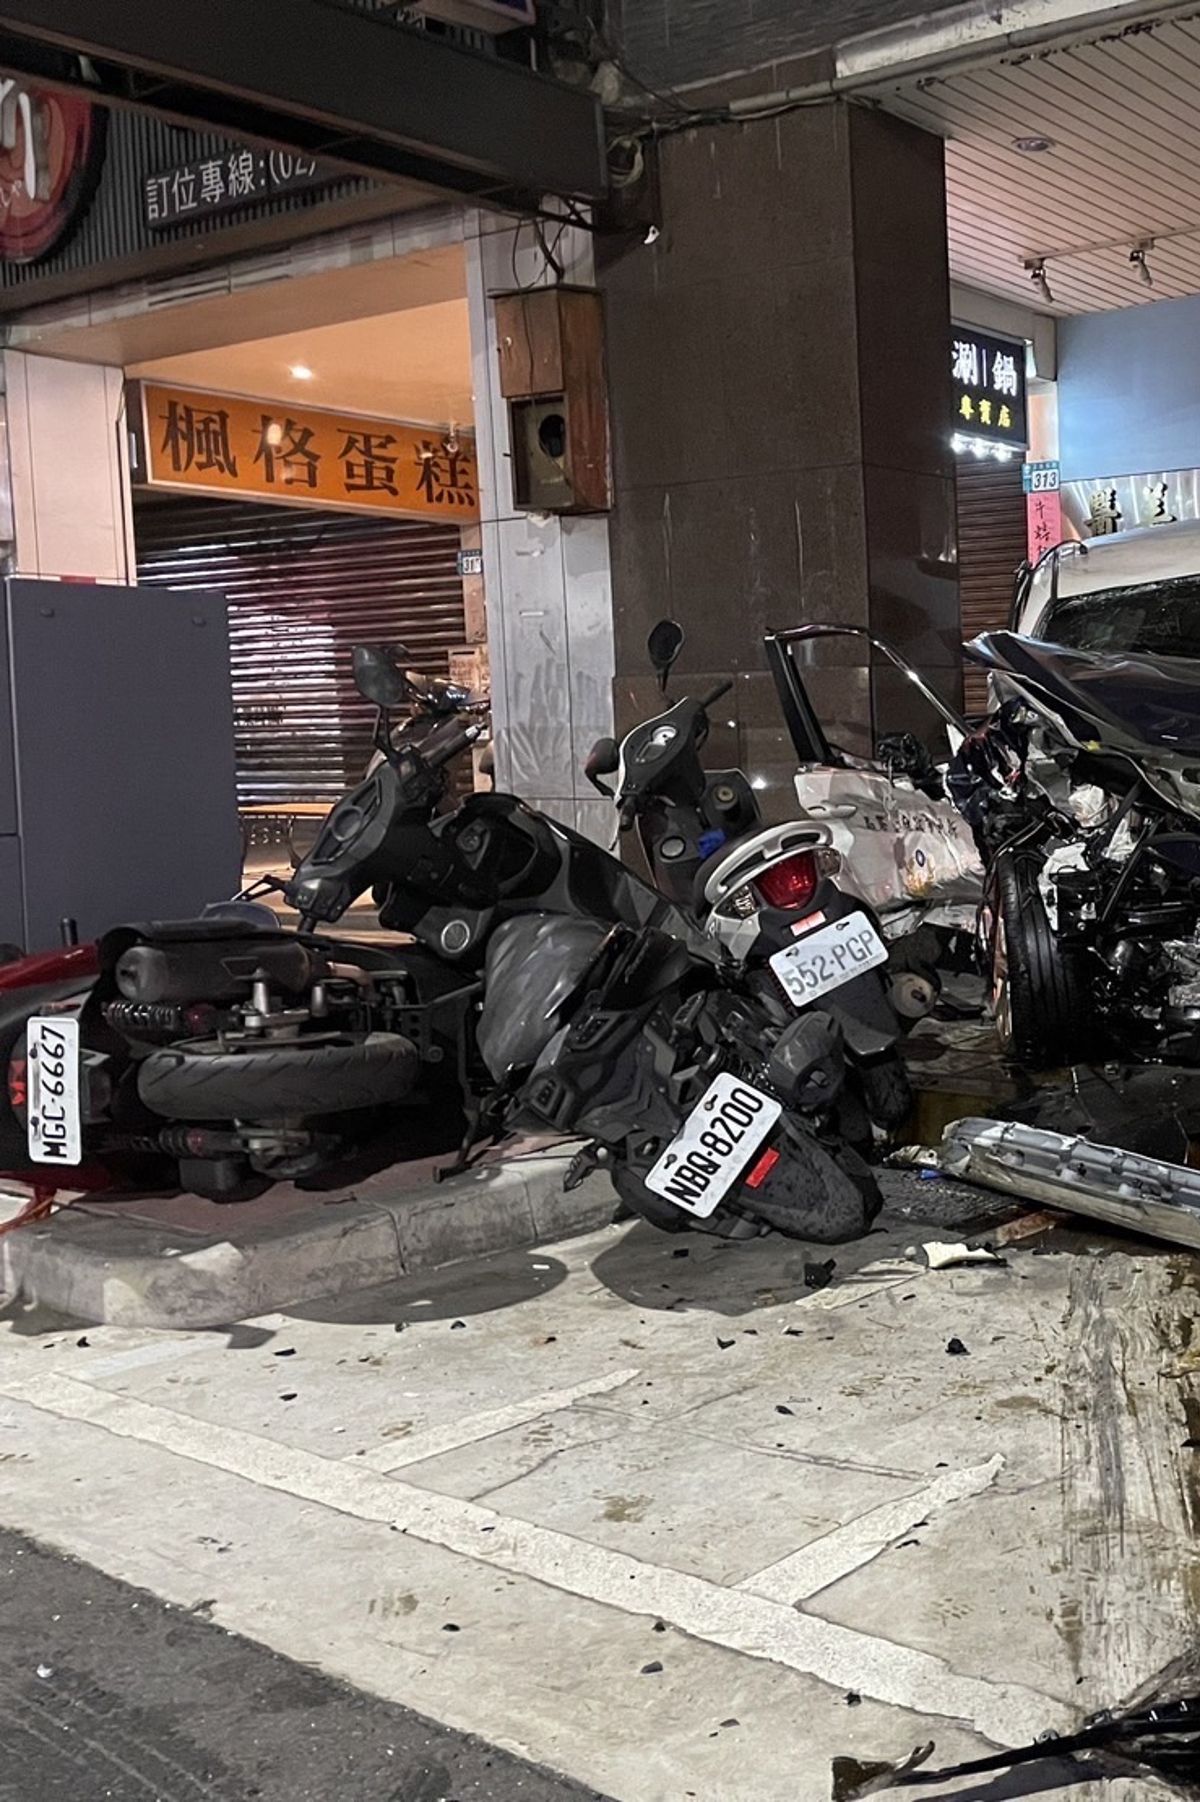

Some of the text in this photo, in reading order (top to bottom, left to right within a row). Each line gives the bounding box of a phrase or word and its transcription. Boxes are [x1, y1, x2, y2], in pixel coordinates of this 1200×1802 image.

[159, 400, 476, 507] 楓格蛋糕
[1034, 471, 1057, 489] 313
